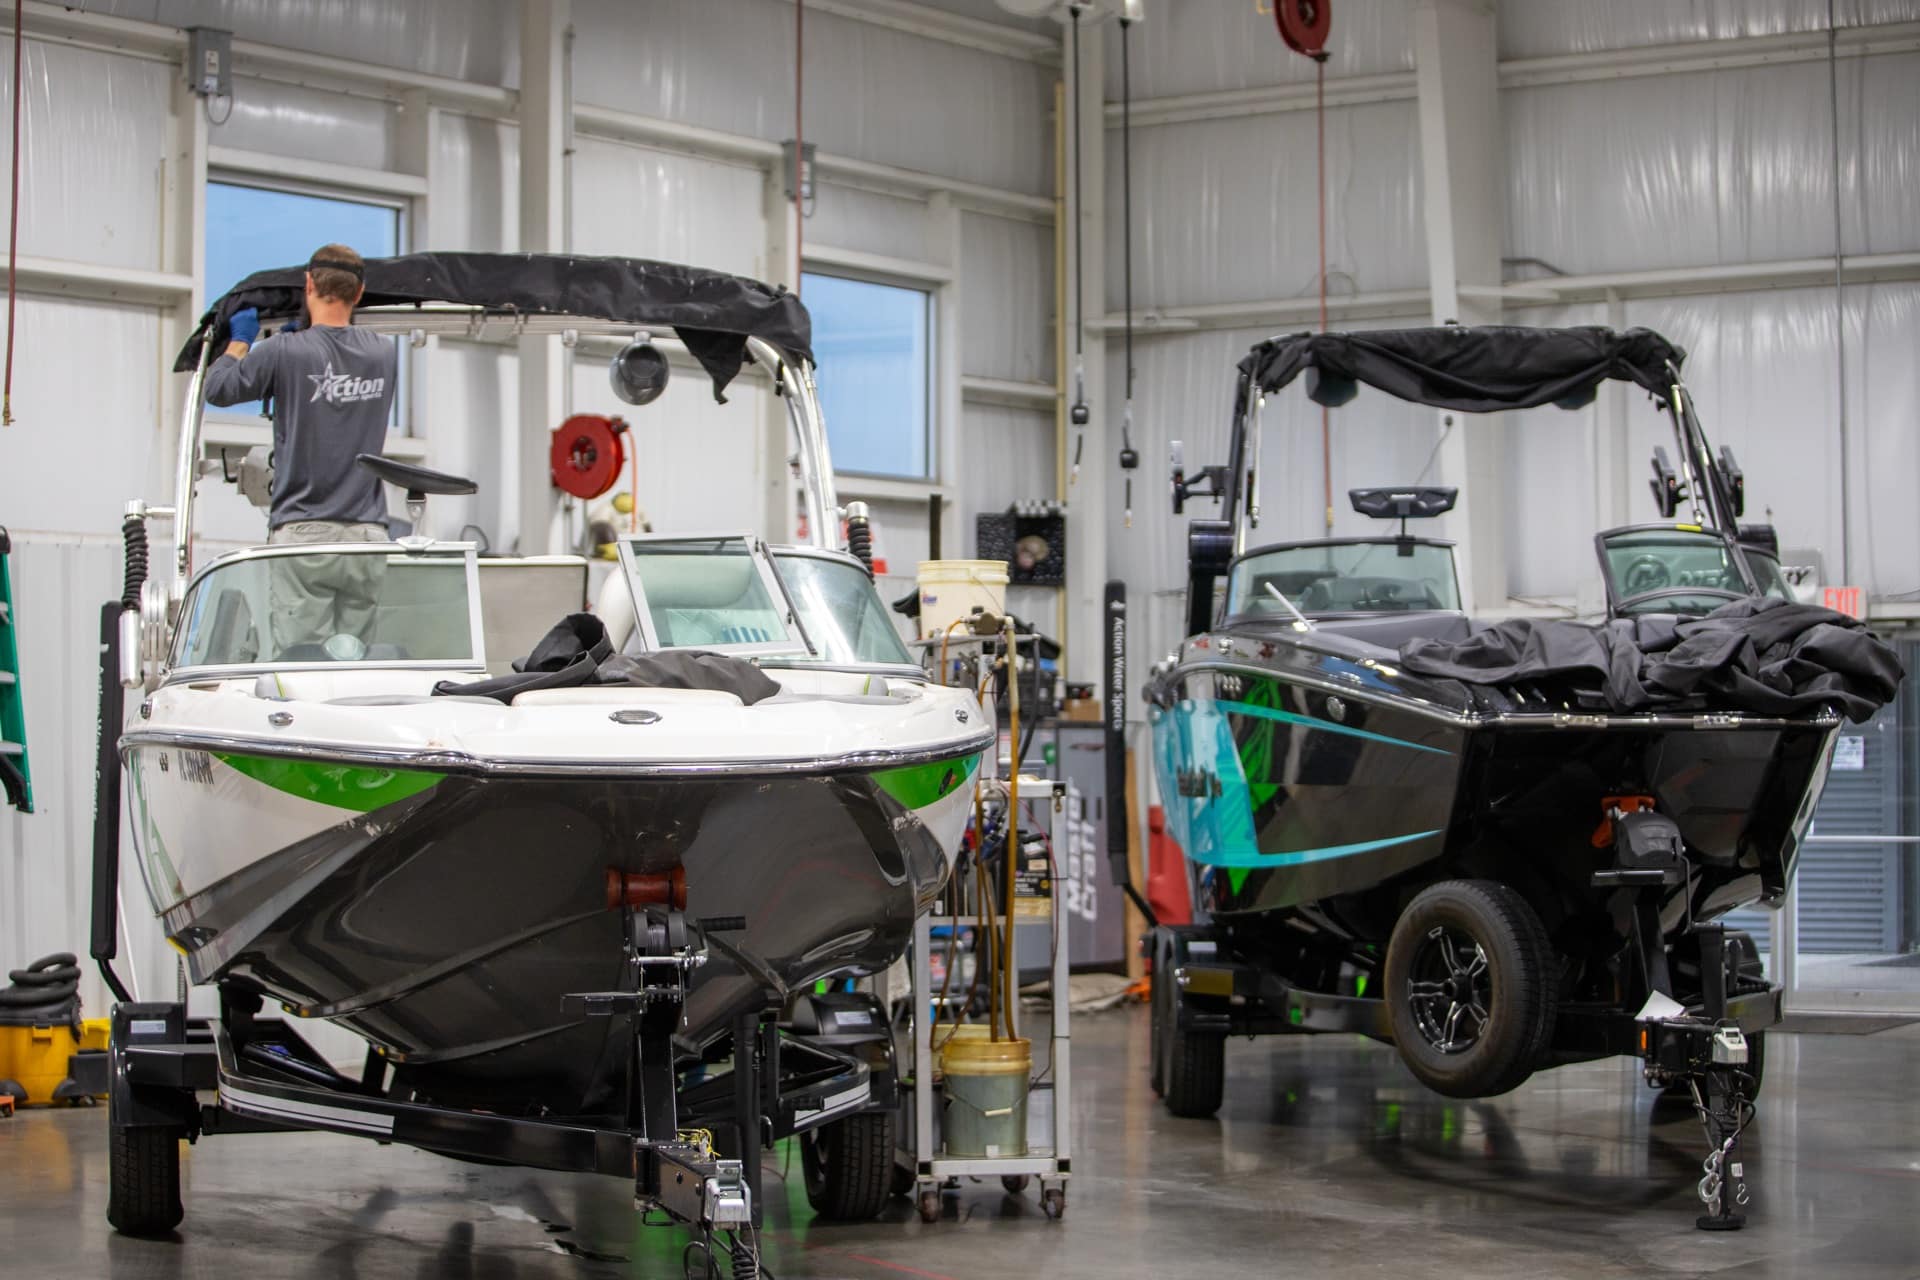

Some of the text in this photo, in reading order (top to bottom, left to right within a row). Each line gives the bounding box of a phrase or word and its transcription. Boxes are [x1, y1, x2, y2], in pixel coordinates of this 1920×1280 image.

[307, 361, 385, 402] Action
[1824, 587, 1861, 620] EXIT
[1111, 616, 1125, 731] Action Water Sports
[1067, 776, 1081, 913] Master
[1081, 820, 1097, 921] Craft
